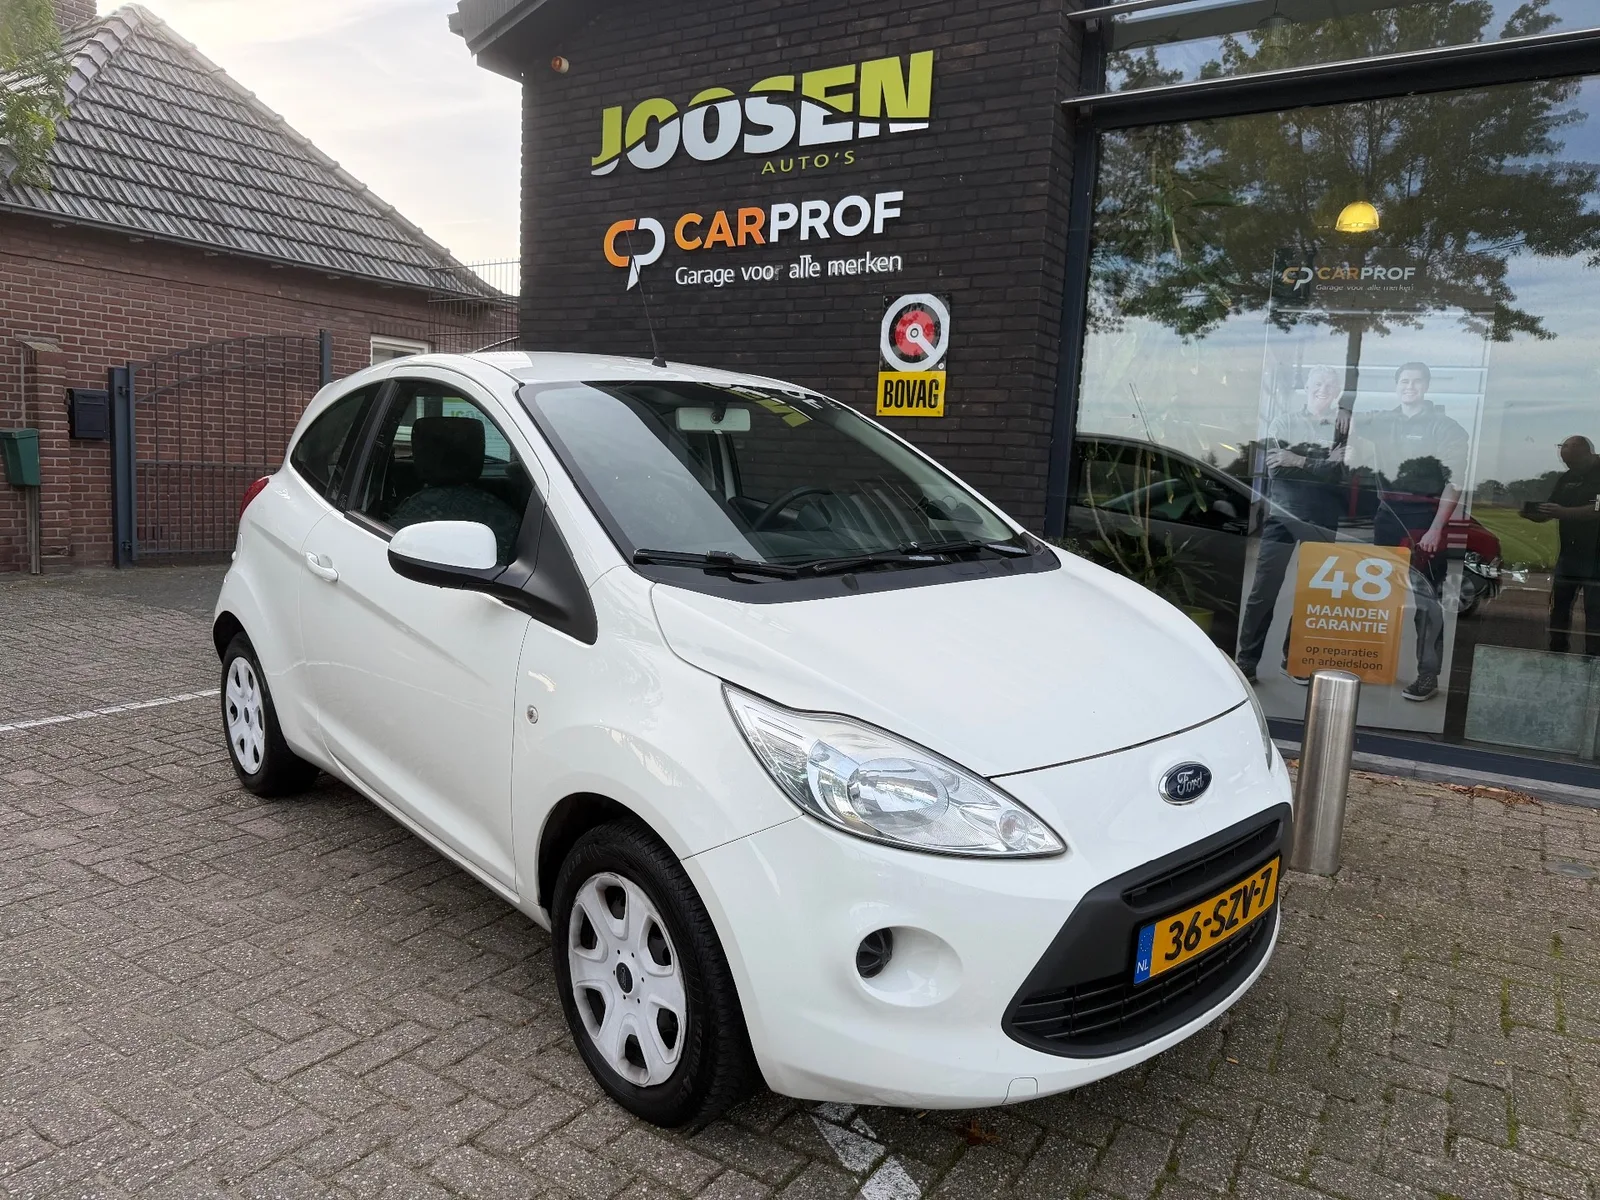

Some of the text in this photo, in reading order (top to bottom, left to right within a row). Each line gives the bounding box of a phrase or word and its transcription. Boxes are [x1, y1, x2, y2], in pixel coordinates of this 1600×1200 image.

[591, 50, 934, 176] JOOSEN
[761, 150, 855, 175] AUTO'S
[674, 190, 904, 251] CARPROF
[675, 266, 735, 287] Garage
[789, 254, 821, 279] alle
[828, 251, 903, 276] merken
[1317, 266, 1416, 280] CARPROF
[1316, 284, 1344, 292] Garage
[883, 379, 939, 409] BOVAG
[1308, 555, 1393, 602] 48
[1306, 604, 1389, 620] MAANDEN
[1305, 617, 1388, 634] GARANTIE
[1302, 657, 1383, 671] en arbeidsloon
[1306, 645, 1378, 659] op reparaties
[1176, 769, 1205, 796] Ford
[1164, 867, 1273, 961] 36-SZV-7
[1136, 959, 1149, 974] NL
